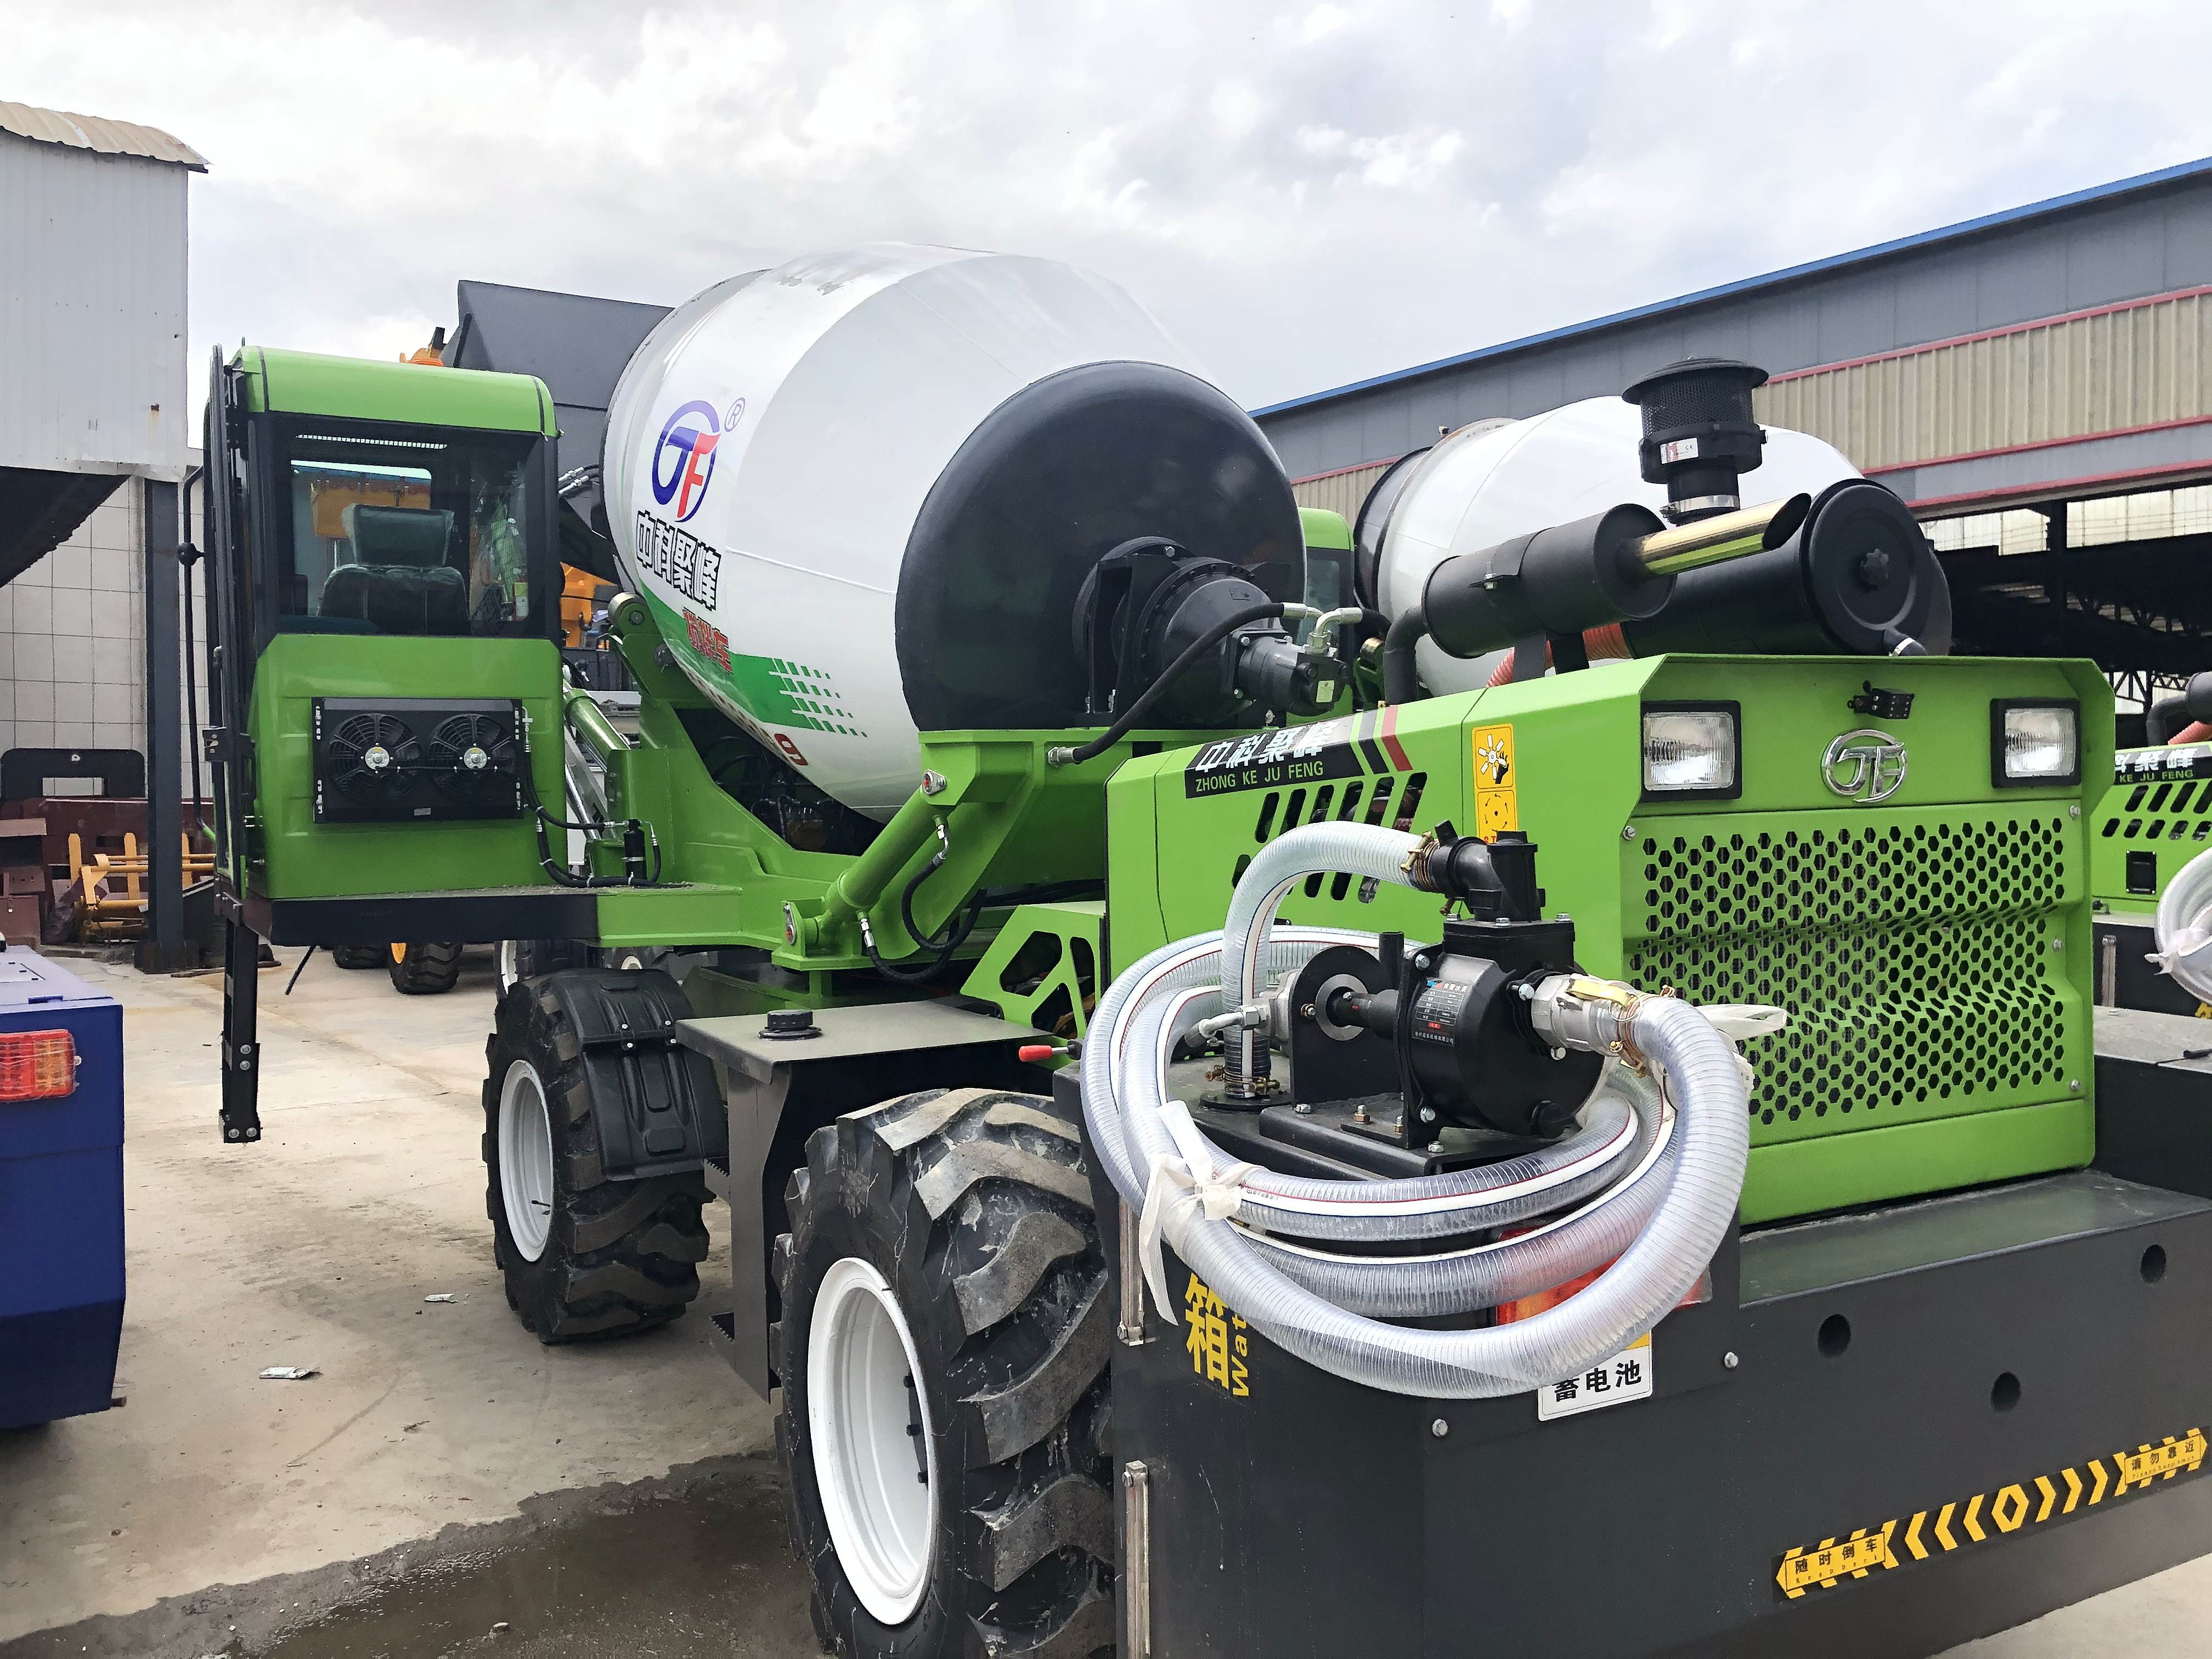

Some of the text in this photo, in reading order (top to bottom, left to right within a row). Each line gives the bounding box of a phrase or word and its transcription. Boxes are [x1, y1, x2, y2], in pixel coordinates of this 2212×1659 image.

[636, 510, 722, 611] 中科聚峰
[1195, 720, 1341, 773] 中科聚峰
[1195, 760, 1324, 792] ZHONG KE JU FENG
[2119, 769, 2193, 783] KE JU FENG
[1483, 835, 1497, 844] ST
[1231, 1313, 1249, 1397] Wat
[2131, 1440, 2196, 1471] 请勿靠近
[1795, 1537, 1878, 1575] 随时倒车
